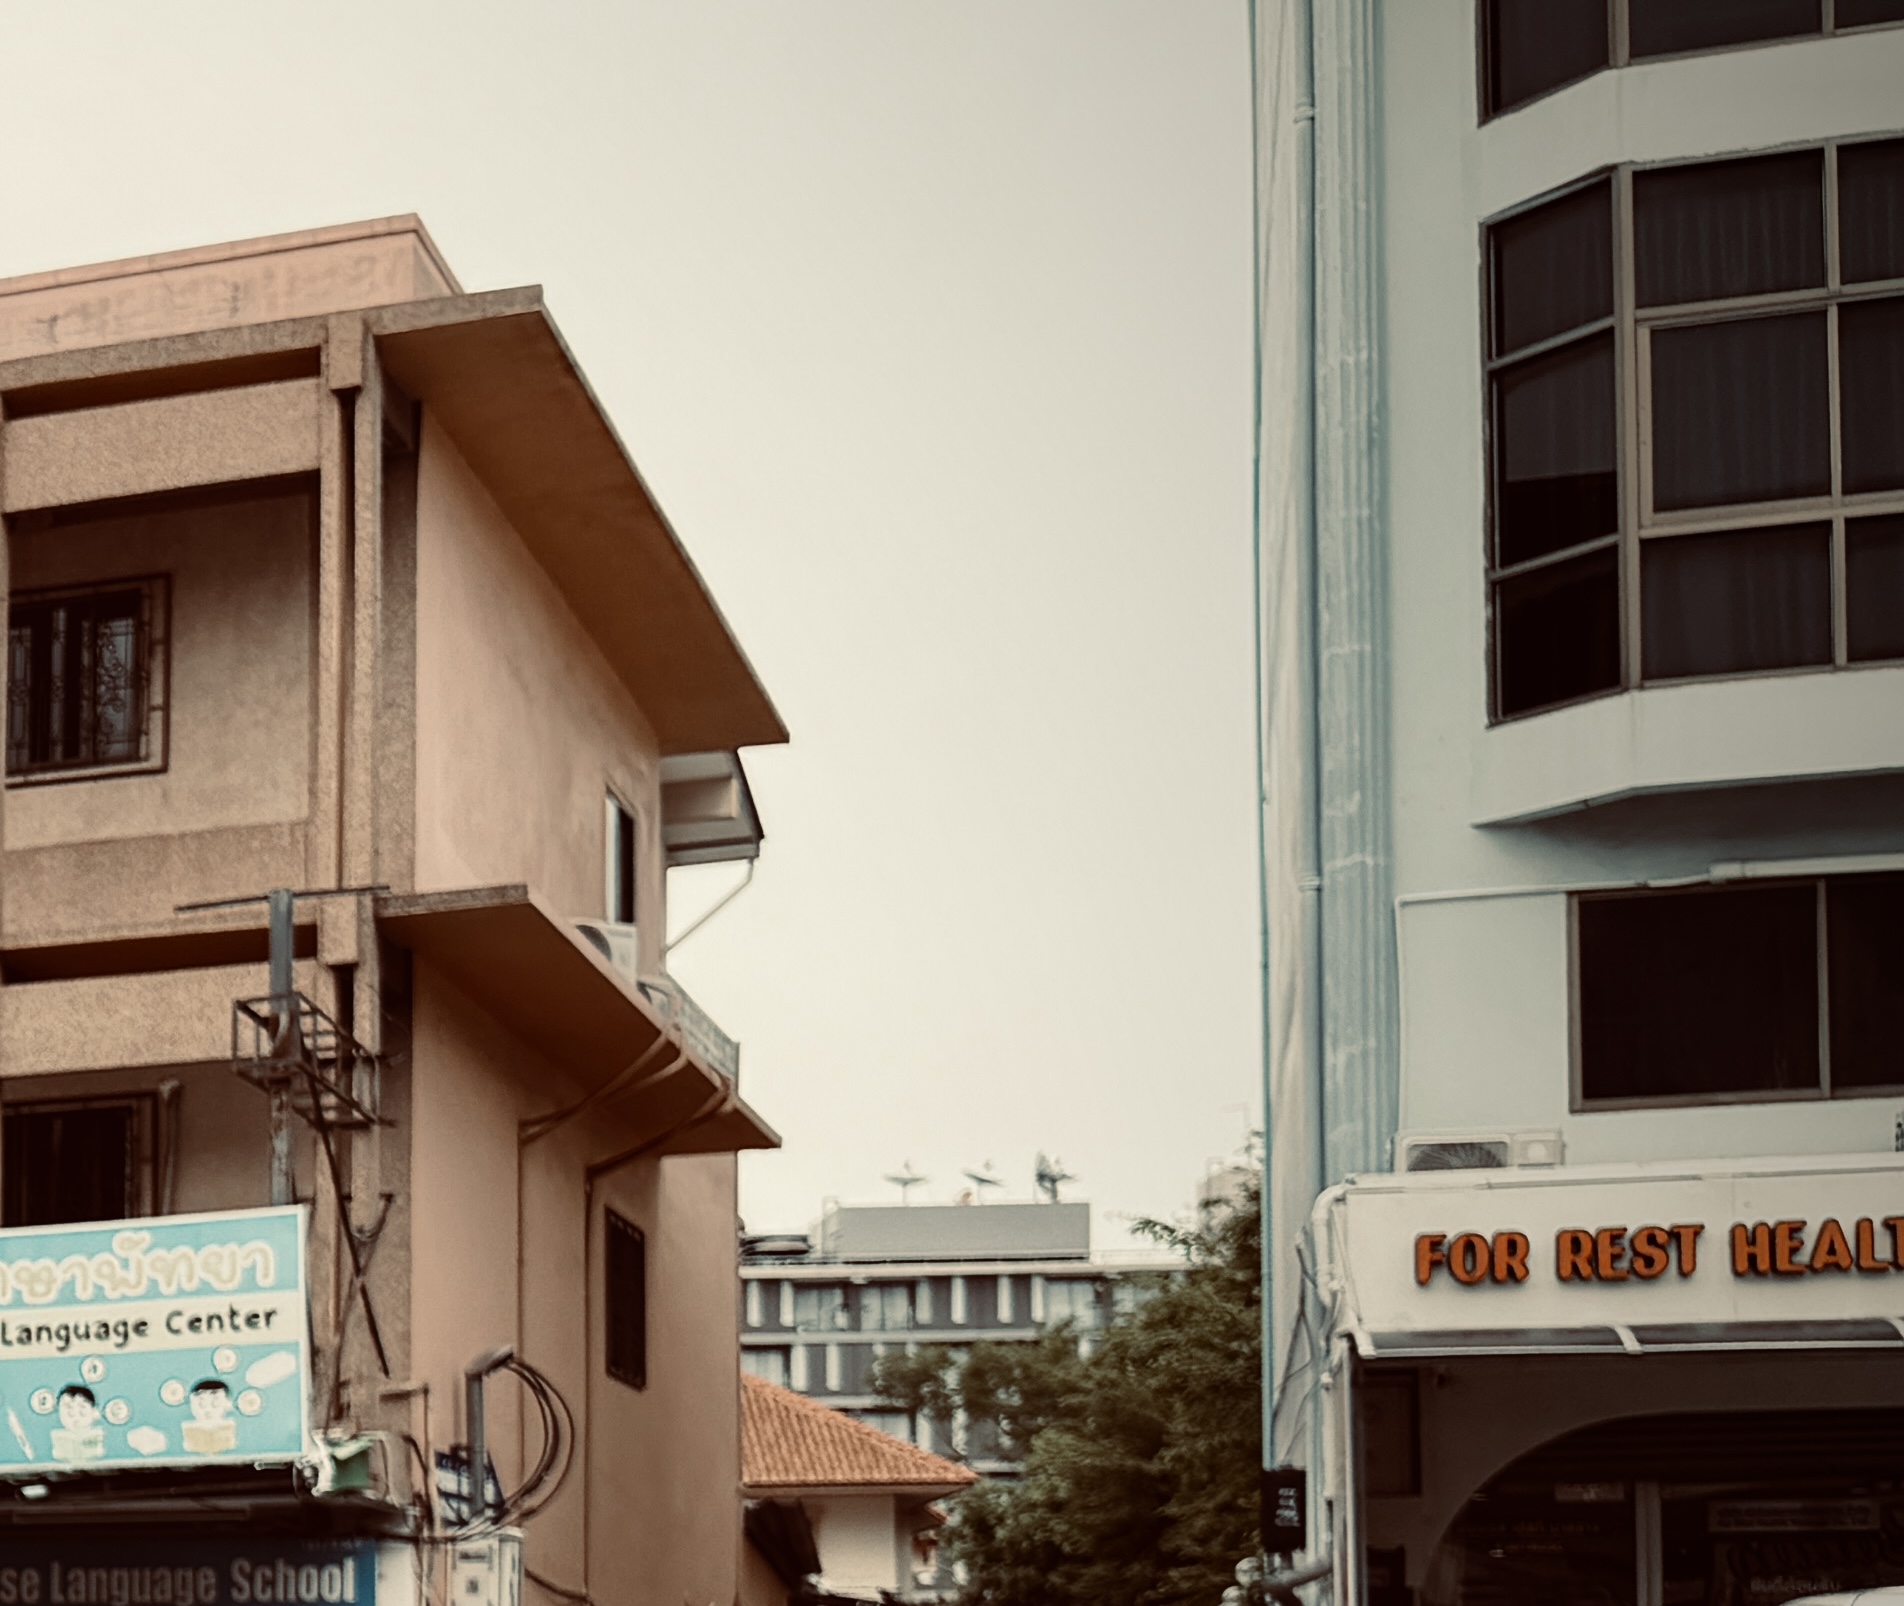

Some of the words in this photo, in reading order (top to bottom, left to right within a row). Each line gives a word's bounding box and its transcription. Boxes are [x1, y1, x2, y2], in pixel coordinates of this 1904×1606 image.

[1415, 1231, 1530, 1285] FOR
[1556, 1223, 1704, 1281] REST
[0, 1317, 150, 1352] Language
[165, 1303, 277, 1335] Center
[230, 1556, 357, 1606] School
